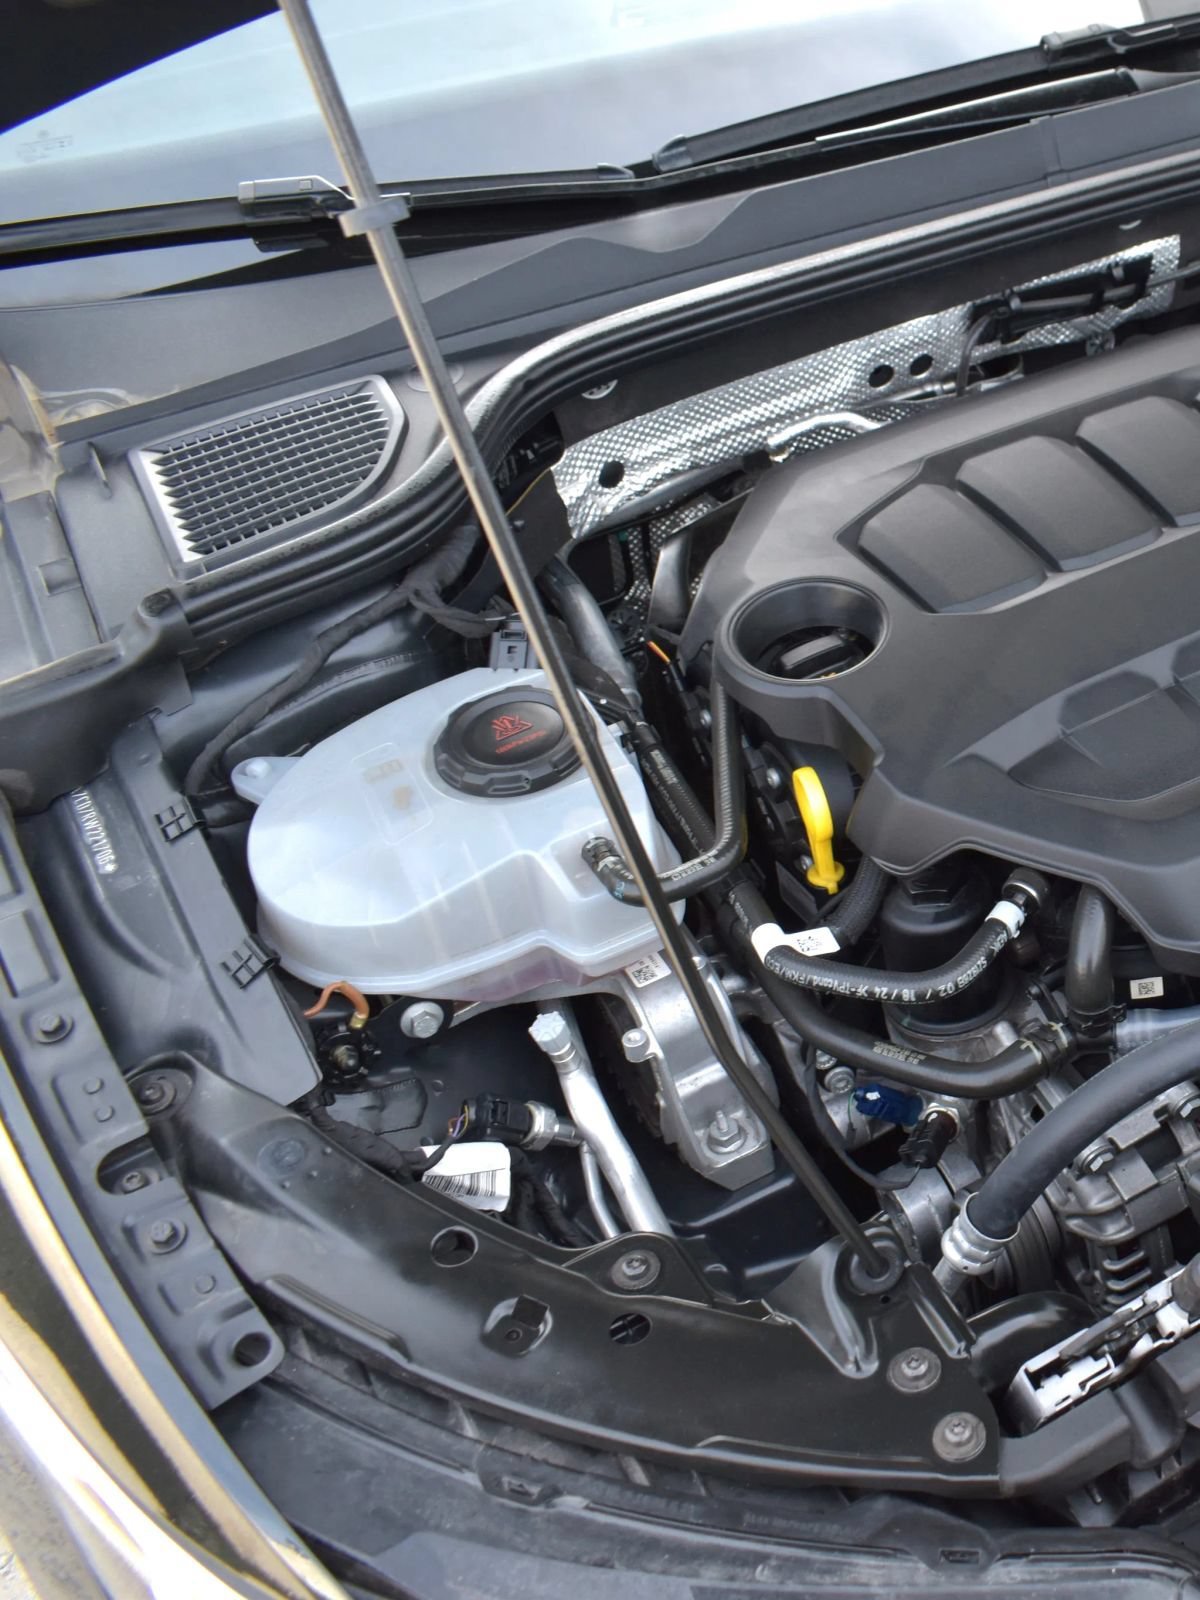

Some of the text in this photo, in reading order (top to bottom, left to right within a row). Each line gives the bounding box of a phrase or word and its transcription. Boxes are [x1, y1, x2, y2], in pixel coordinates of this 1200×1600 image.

[873, 987, 889, 1000] 24
[902, 989, 917, 1002] 18
[937, 982, 954, 998] 02
